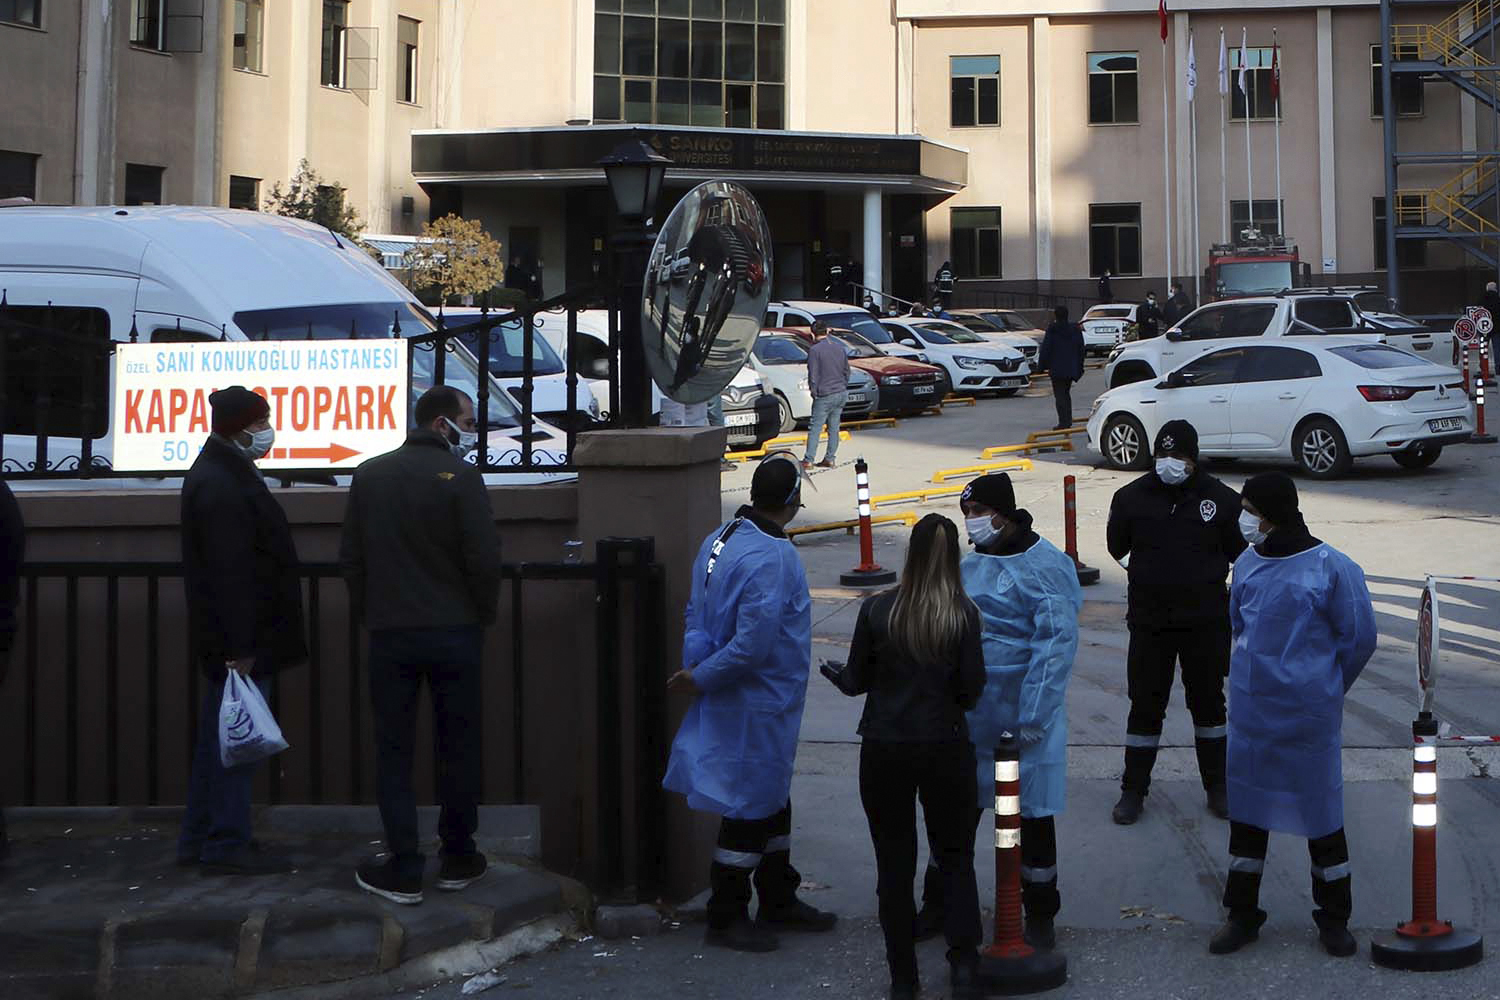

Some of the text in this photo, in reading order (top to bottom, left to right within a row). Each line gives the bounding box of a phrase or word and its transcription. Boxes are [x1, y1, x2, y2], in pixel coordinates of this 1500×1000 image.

[126, 361, 151, 373] ÖZEL
[201, 346, 300, 372] KONUKOĞLU
[308, 343, 398, 370] HASTANESİ
[124, 385, 397, 433] KAPA TOPARK
[163, 441, 189, 461] 50
